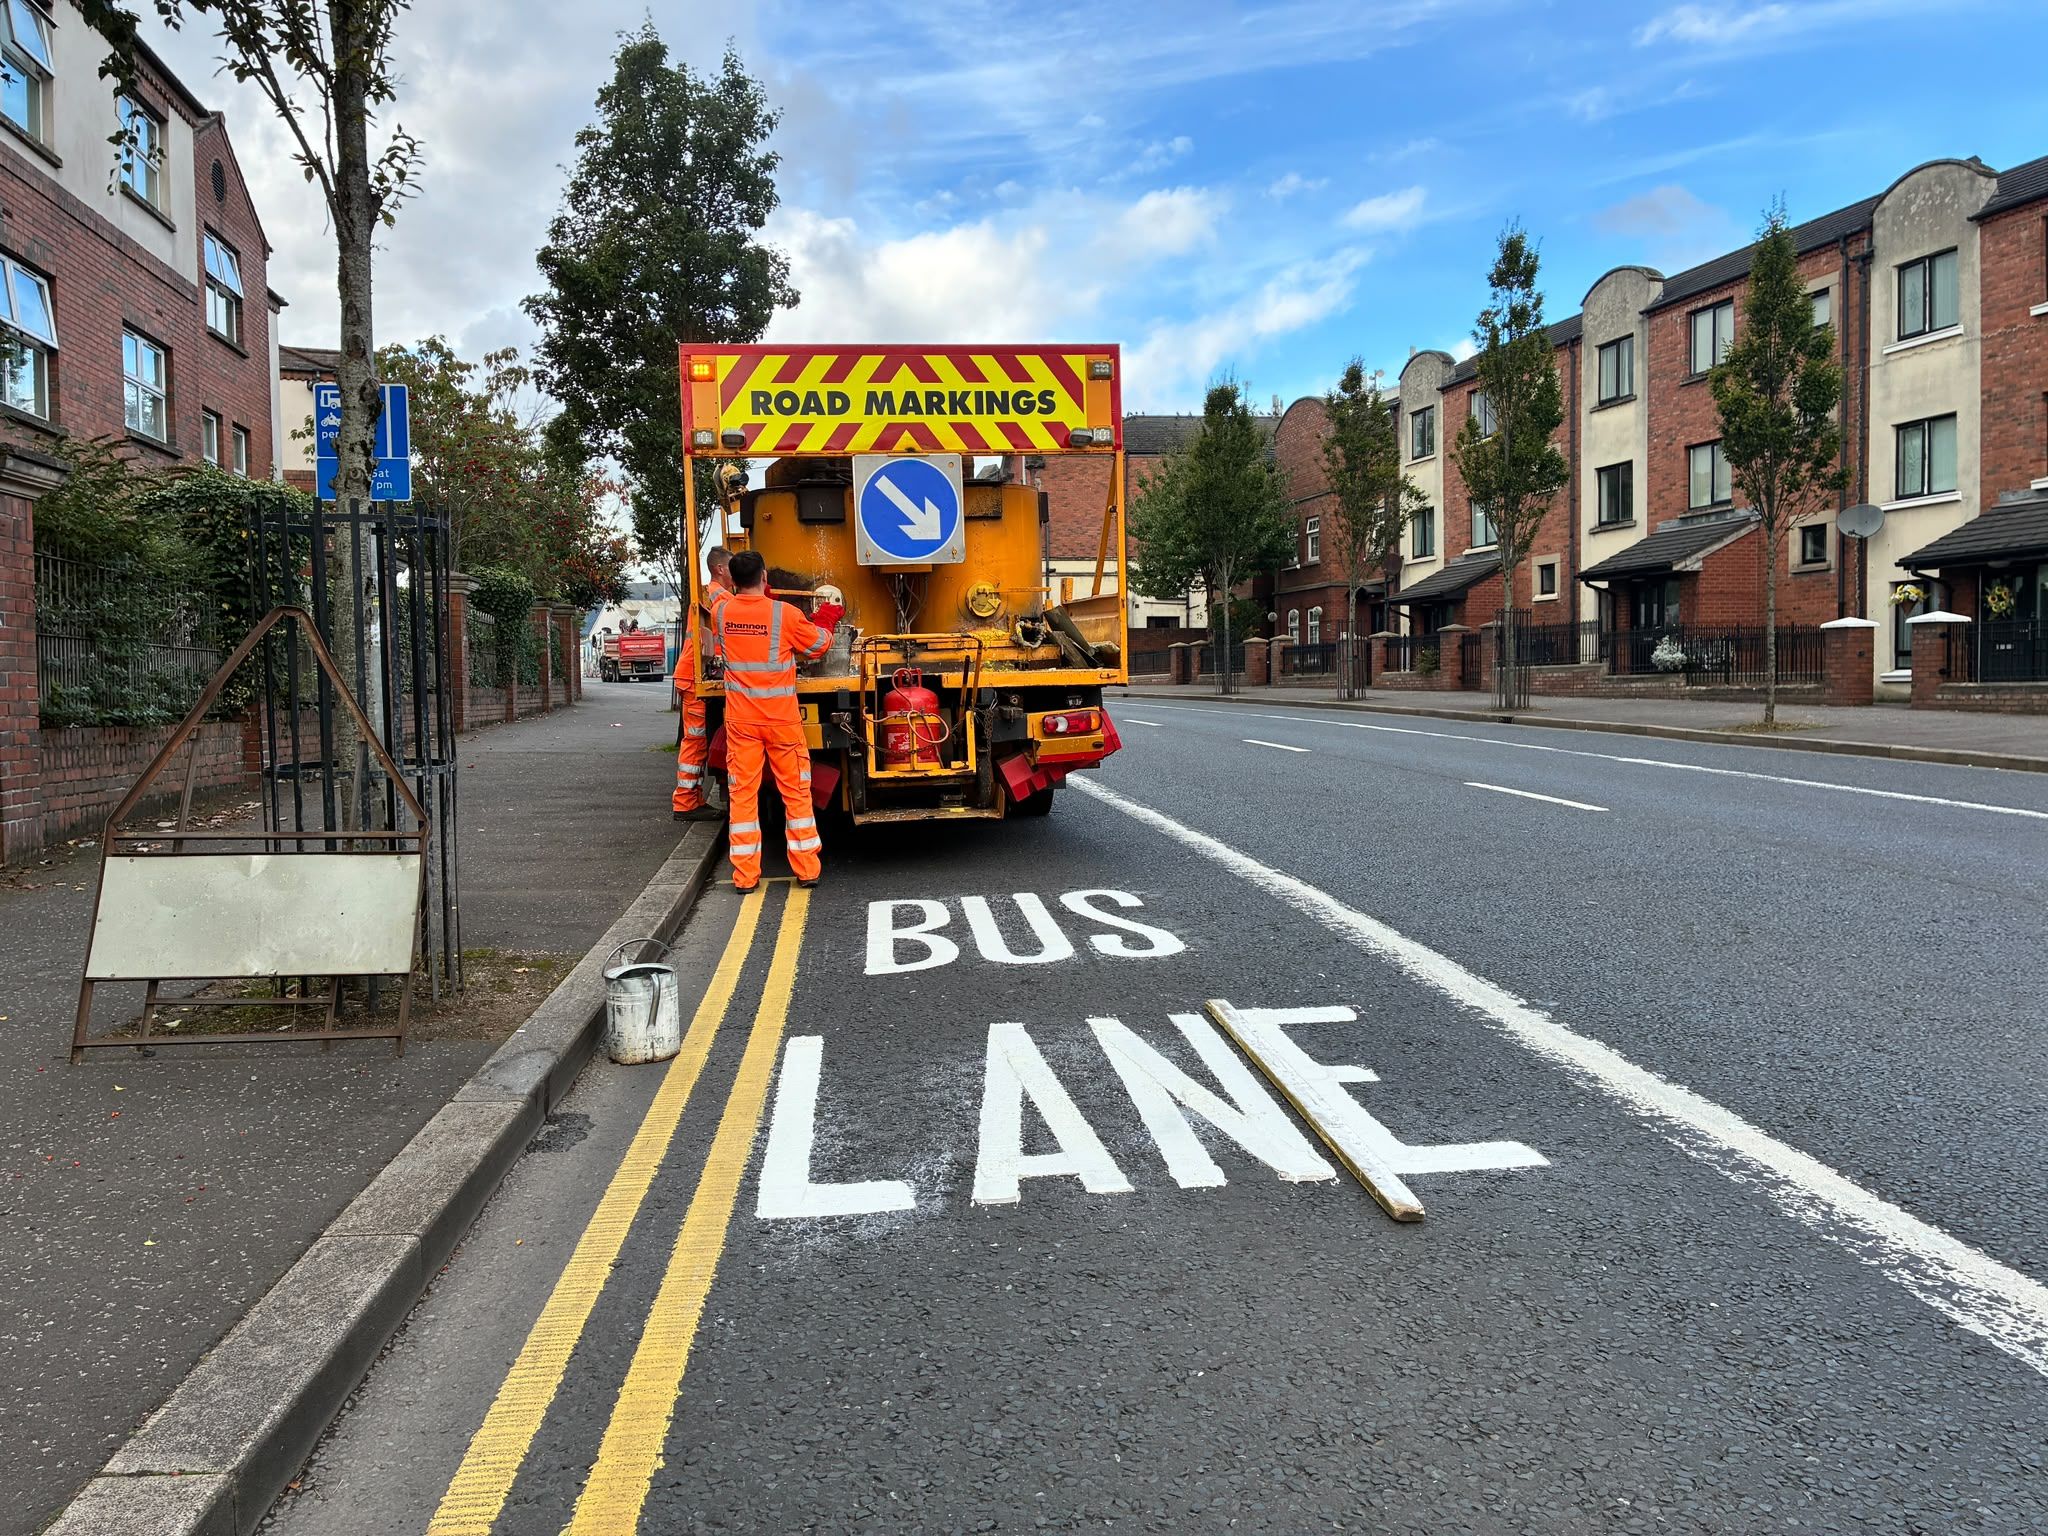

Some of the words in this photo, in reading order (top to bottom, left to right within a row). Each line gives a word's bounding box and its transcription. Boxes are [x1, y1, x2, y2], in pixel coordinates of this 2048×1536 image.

[750, 389, 850, 415] ROAD
[864, 389, 1057, 415] MARKINGS
[321, 431, 340, 440] per
[725, 621, 768, 631] Shannon
[863, 888, 1186, 977] BUS
[755, 1005, 1552, 1221] LANE
